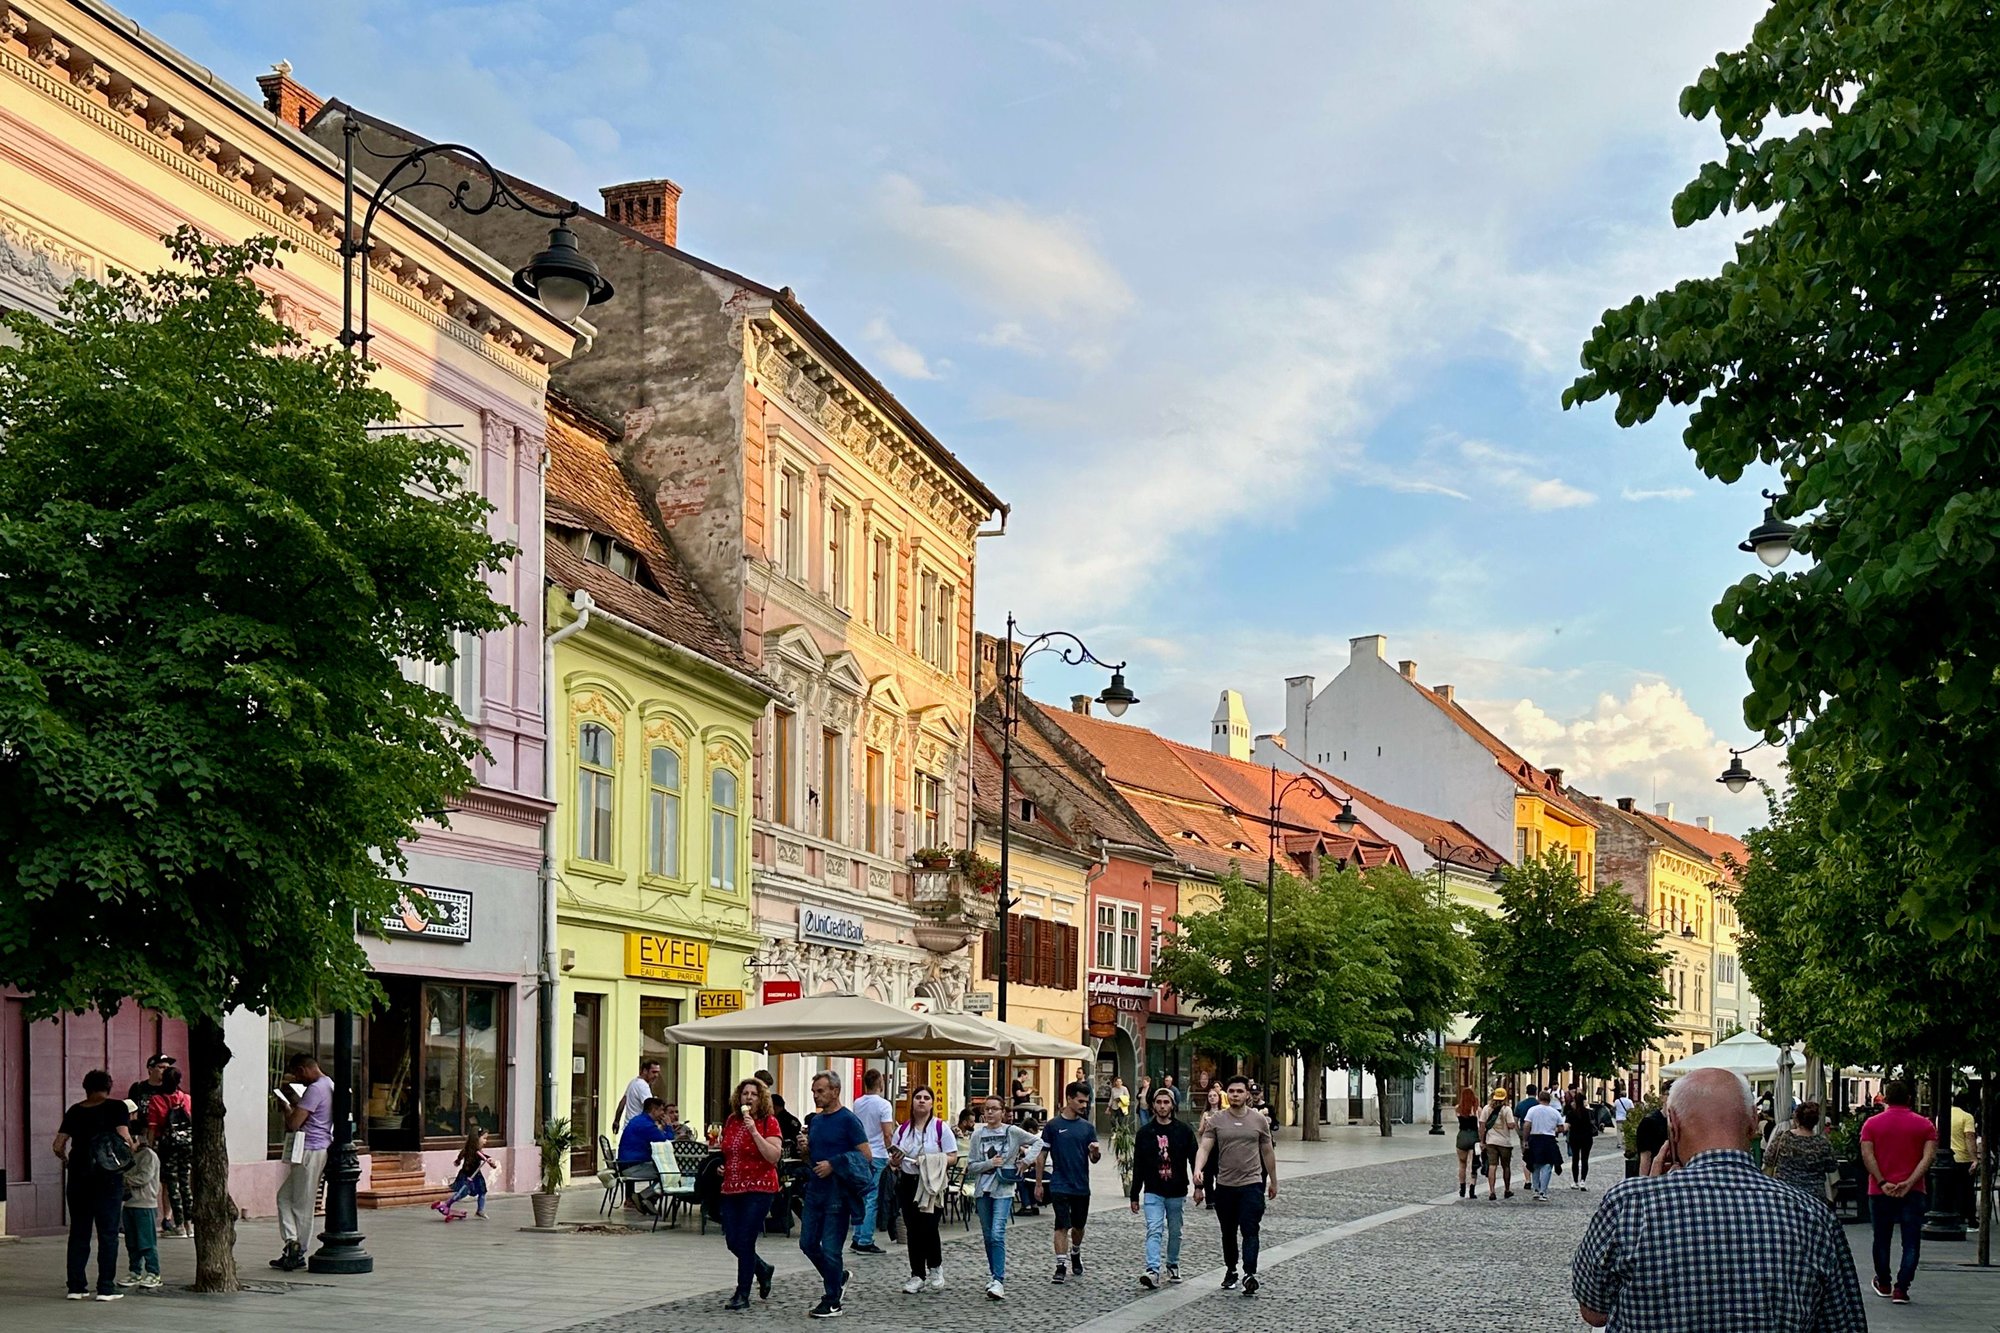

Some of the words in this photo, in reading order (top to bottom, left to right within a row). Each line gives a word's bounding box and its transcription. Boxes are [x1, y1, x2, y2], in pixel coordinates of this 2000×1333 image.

[815, 914, 846, 937] UniCredit
[847, 920, 864, 941] Bank
[641, 936, 704, 968] EYFEL
[641, 968, 655, 977] EAU
[661, 970, 671, 979] DE
[677, 972, 703, 982] PARFUM
[700, 994, 739, 1007] EYFEL
